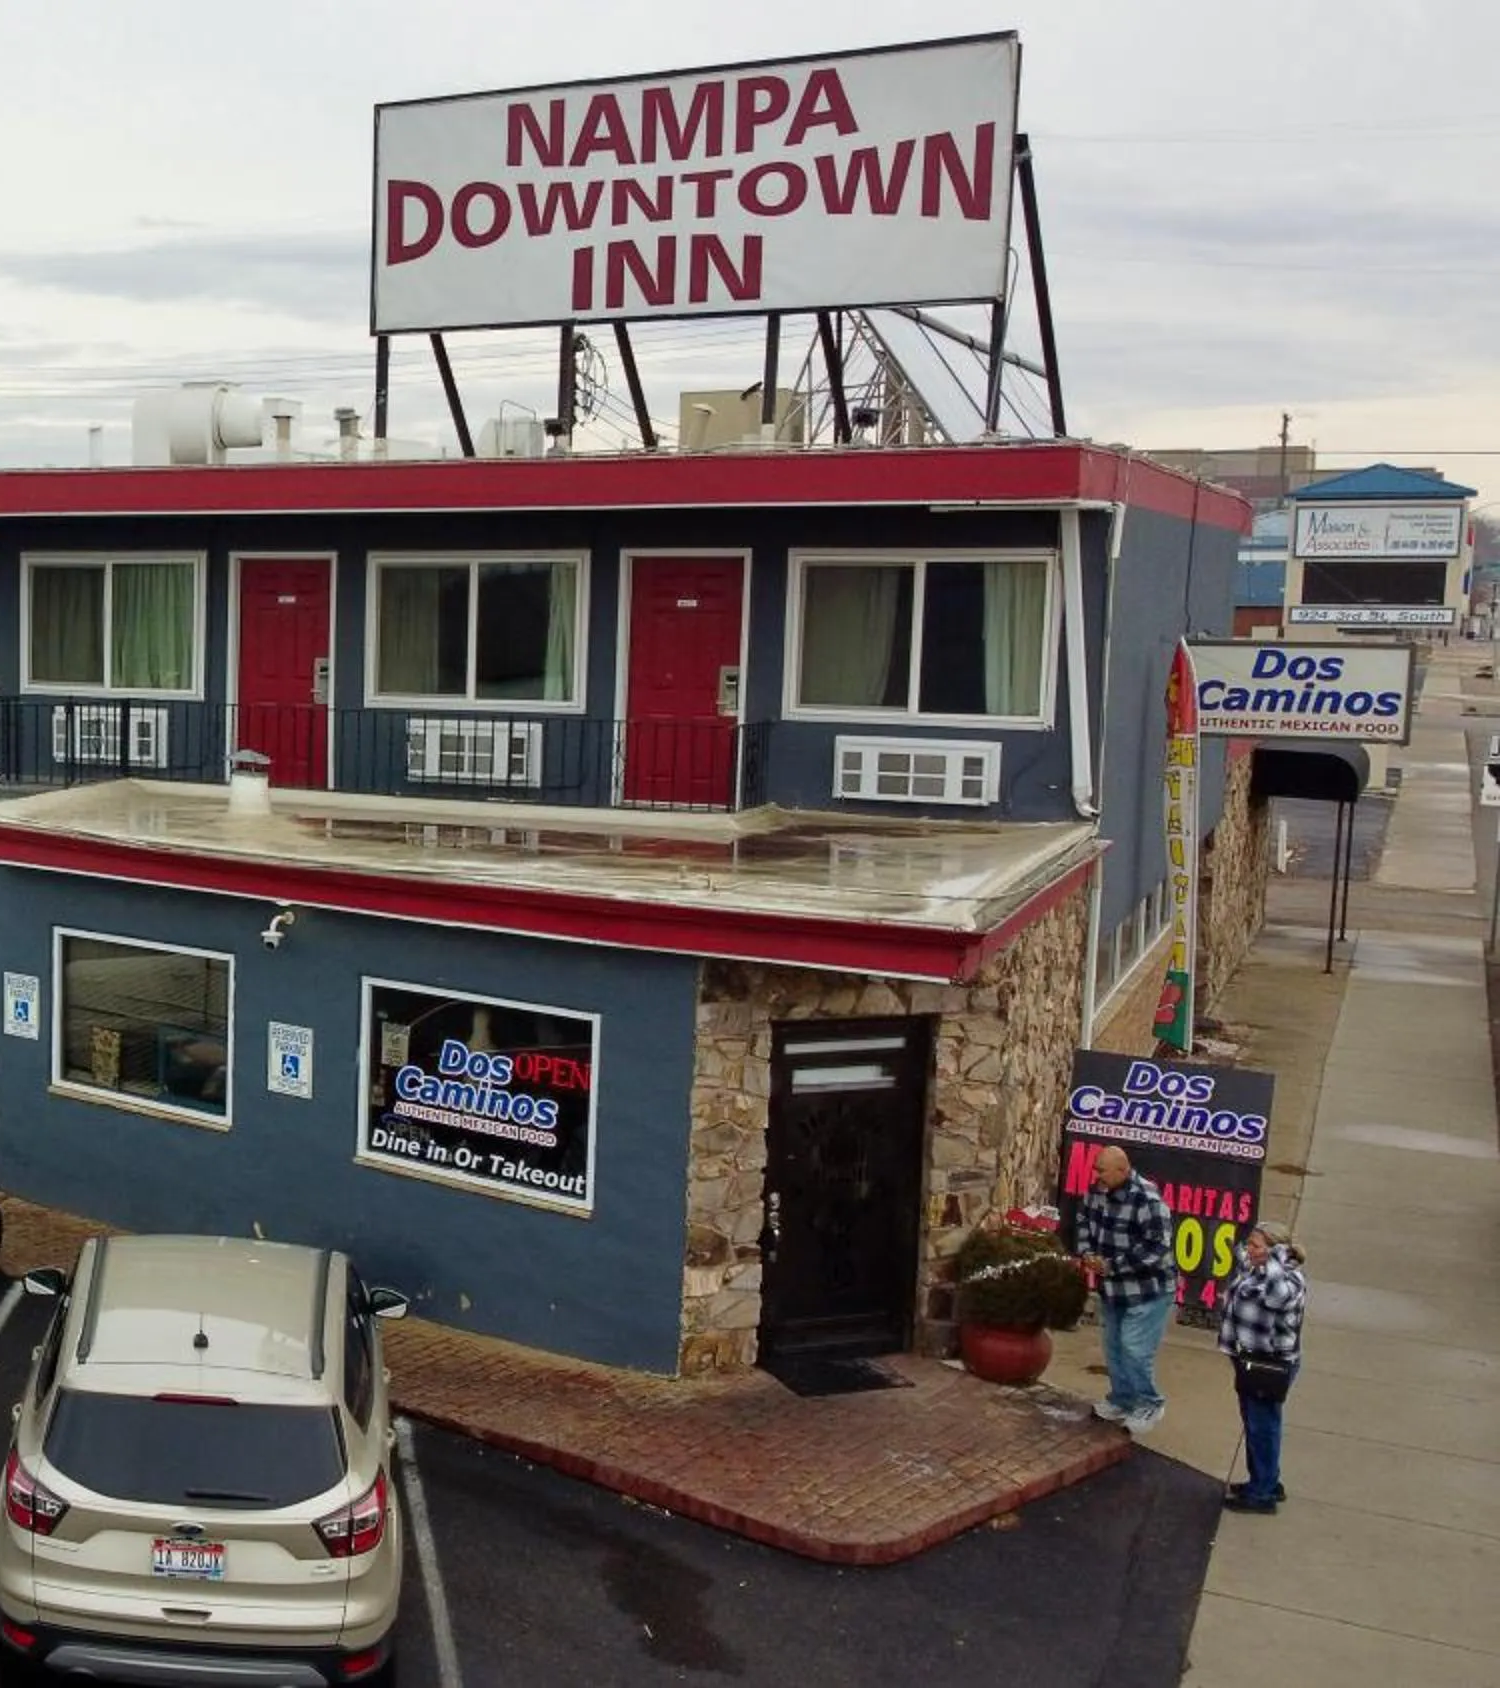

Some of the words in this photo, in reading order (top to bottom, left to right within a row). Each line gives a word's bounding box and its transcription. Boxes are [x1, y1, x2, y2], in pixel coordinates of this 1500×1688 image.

[506, 68, 858, 168] NAMPA
[386, 121, 996, 266] DOWNTOWN
[571, 234, 764, 311] INN
[1304, 535, 1370, 552] Associates
[1308, 511, 1354, 535] Mason
[1336, 611, 1362, 621] 3rd
[1397, 611, 1445, 621] South
[1251, 649, 1344, 681] Dos
[1198, 680, 1402, 716] Caminos
[1200, 717, 1275, 730] UTHENTIC
[1280, 720, 1352, 733] MEXICAN
[1355, 723, 1399, 734] FOOD
[439, 1039, 514, 1085] Dos
[515, 1052, 590, 1091] OPEN
[1124, 1060, 1215, 1101] Dos
[396, 1065, 559, 1129] Caminos
[1069, 1085, 1267, 1142] Caminos
[394, 1101, 462, 1127] AUTHENTIC
[462, 1114, 519, 1140] MEXICAN
[519, 1127, 557, 1148] FOOD
[1066, 1119, 1150, 1142] AUTHENTIC
[1151, 1131, 1219, 1152] MEXICAN
[1220, 1140, 1265, 1159] FOOD
[371, 1128, 420, 1156] Dine
[426, 1139, 447, 1162] in
[454, 1147, 483, 1168] Or
[490, 1153, 586, 1194] Takeout
